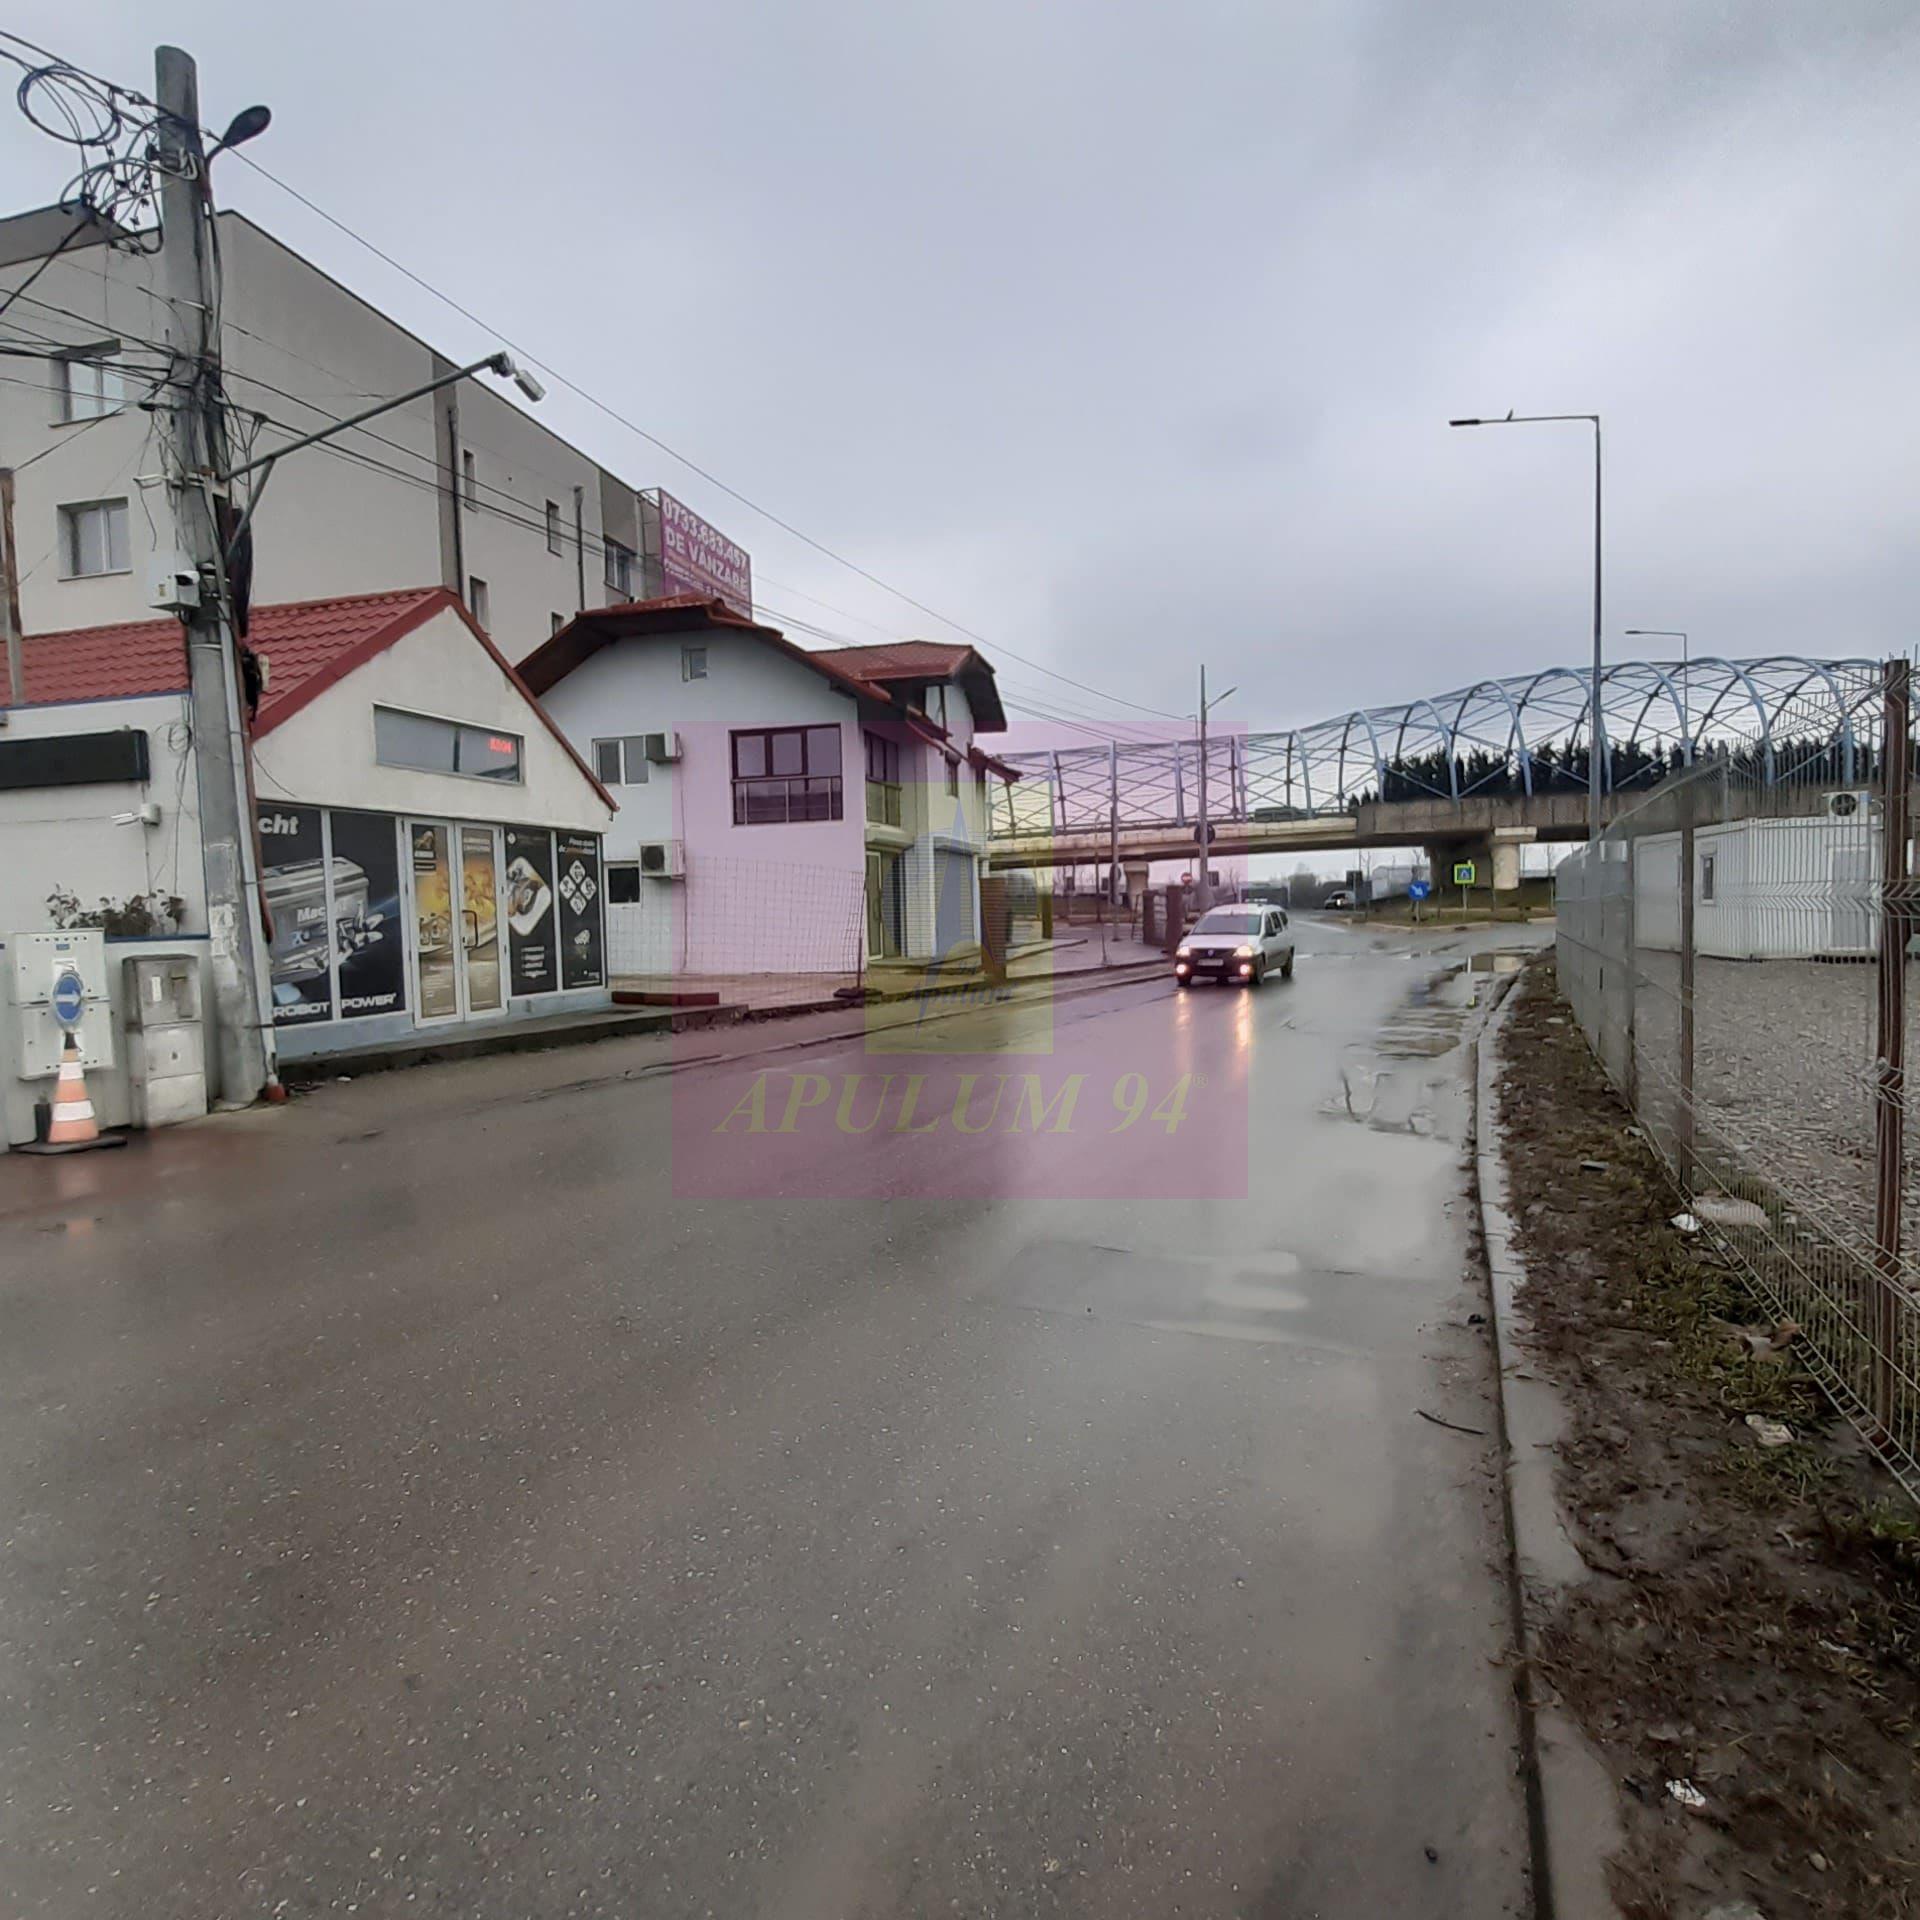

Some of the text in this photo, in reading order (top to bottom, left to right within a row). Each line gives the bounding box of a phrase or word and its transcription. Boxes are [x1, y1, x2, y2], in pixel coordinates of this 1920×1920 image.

[664, 525, 686, 555] DE
[273, 994, 396, 1017] ROBOT POWER
